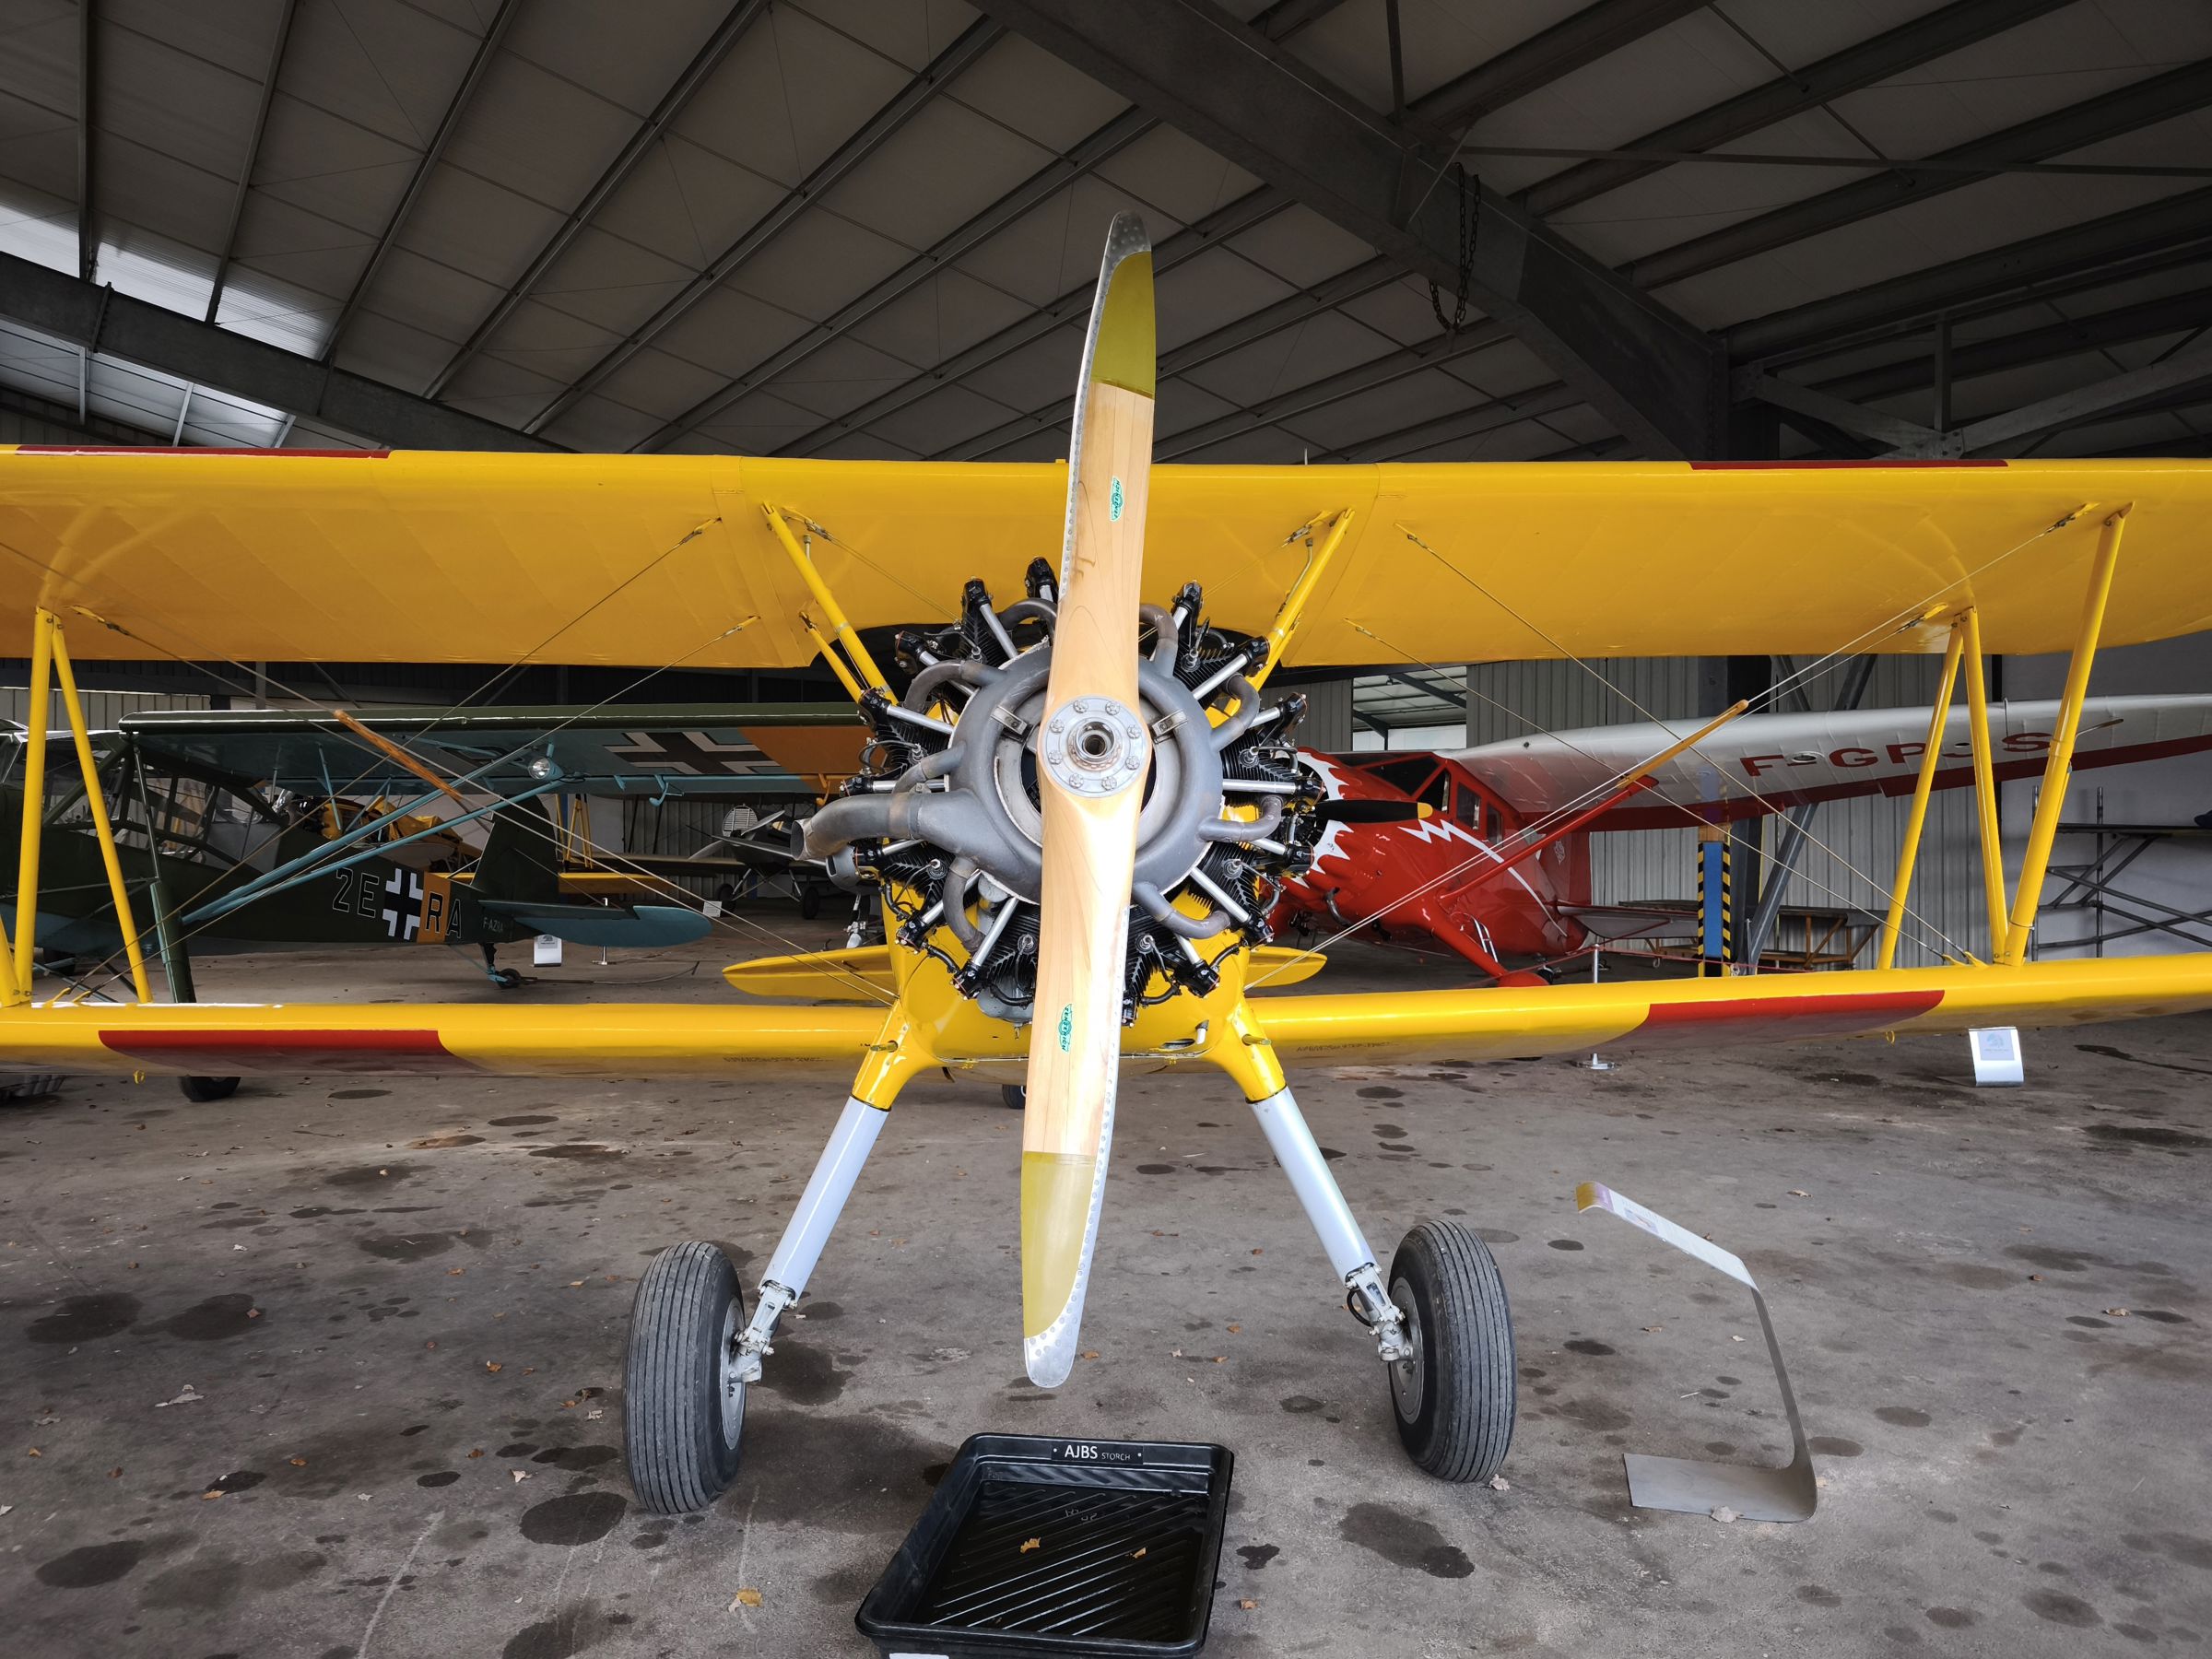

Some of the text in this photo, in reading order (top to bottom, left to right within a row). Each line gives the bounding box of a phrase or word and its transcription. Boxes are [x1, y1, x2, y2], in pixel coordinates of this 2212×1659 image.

[333, 867, 461, 938] 2E RA
[1065, 1444, 1130, 1461] AJBS STORCH
